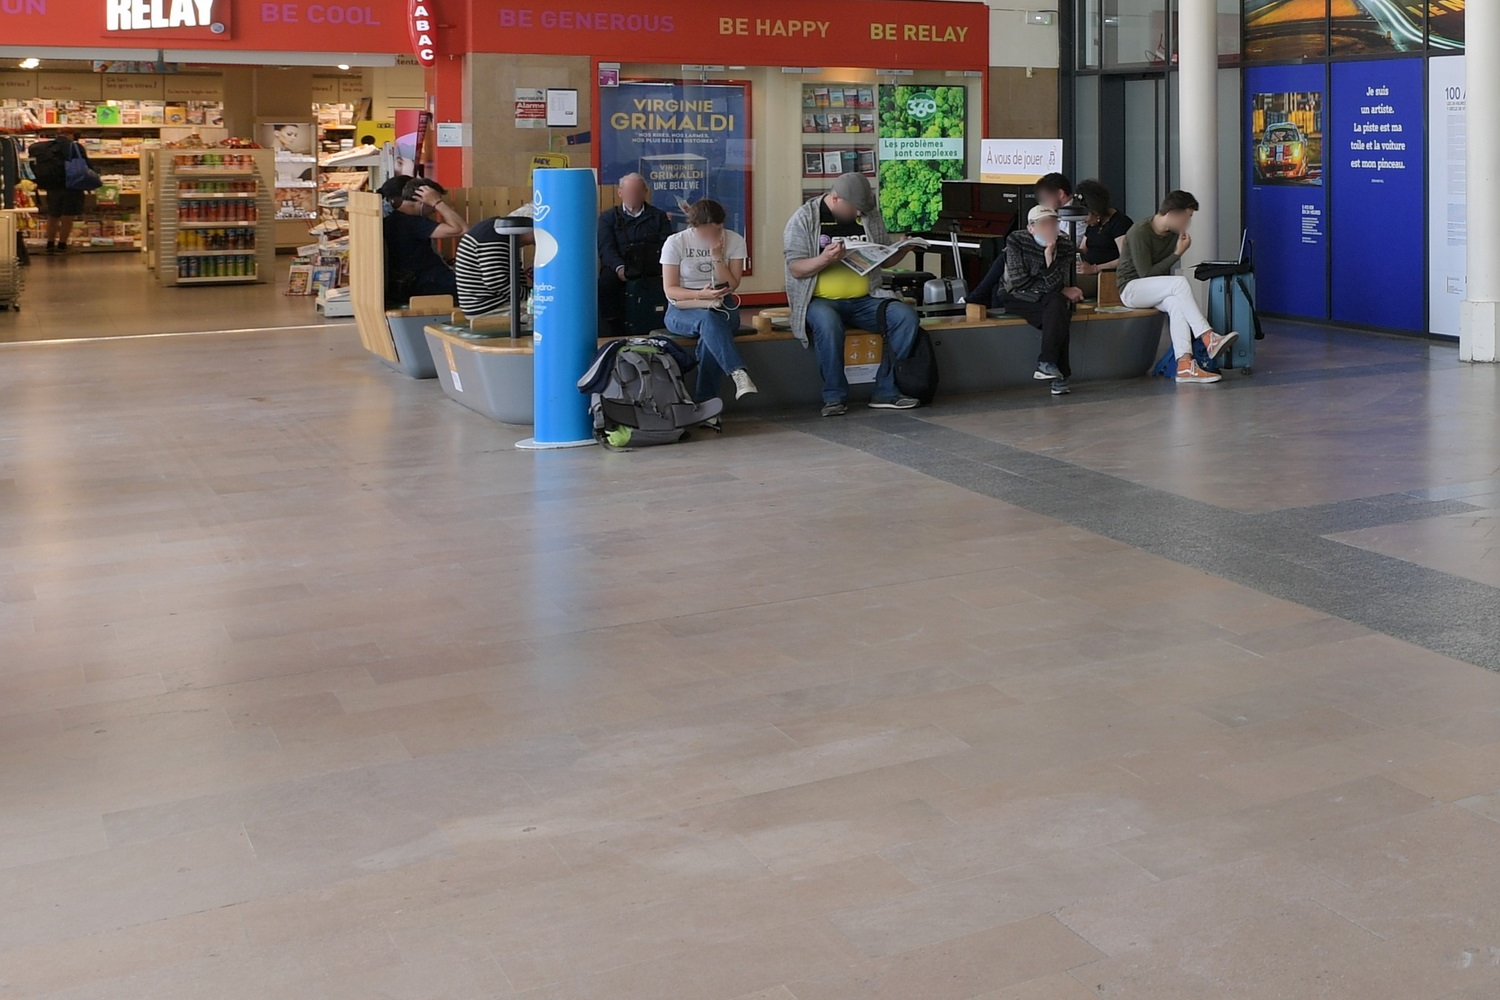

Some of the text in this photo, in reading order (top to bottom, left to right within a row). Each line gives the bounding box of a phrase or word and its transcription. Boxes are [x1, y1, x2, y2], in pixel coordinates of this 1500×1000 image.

[261, 3, 380, 26] BE COOL
[500, 8, 676, 33] BE GENEROUS
[719, 18, 830, 38] BE HAPPY
[870, 23, 968, 42] BE RELAY
[1366, 85, 1389, 96] Je suis
[1445, 86, 1460, 100] 100
[633, 98, 714, 112] VIRGINIE
[1371, 103, 1394, 114] artiste.
[610, 112, 734, 131] GRIMALDI
[1354, 121, 1402, 134] La piste est ma
[900, 140, 944, 150] problèmes
[1350, 139, 1406, 150] toile et la voiture
[914, 150, 958, 158] complexes
[986, 146, 1043, 170] À vous de jouer
[1350, 159, 1360, 168] est
[1378, 158, 1406, 171] pinceau.
[650, 171, 704, 180] GRIMALDI
[654, 181, 700, 190] UNE BELLE VIE
